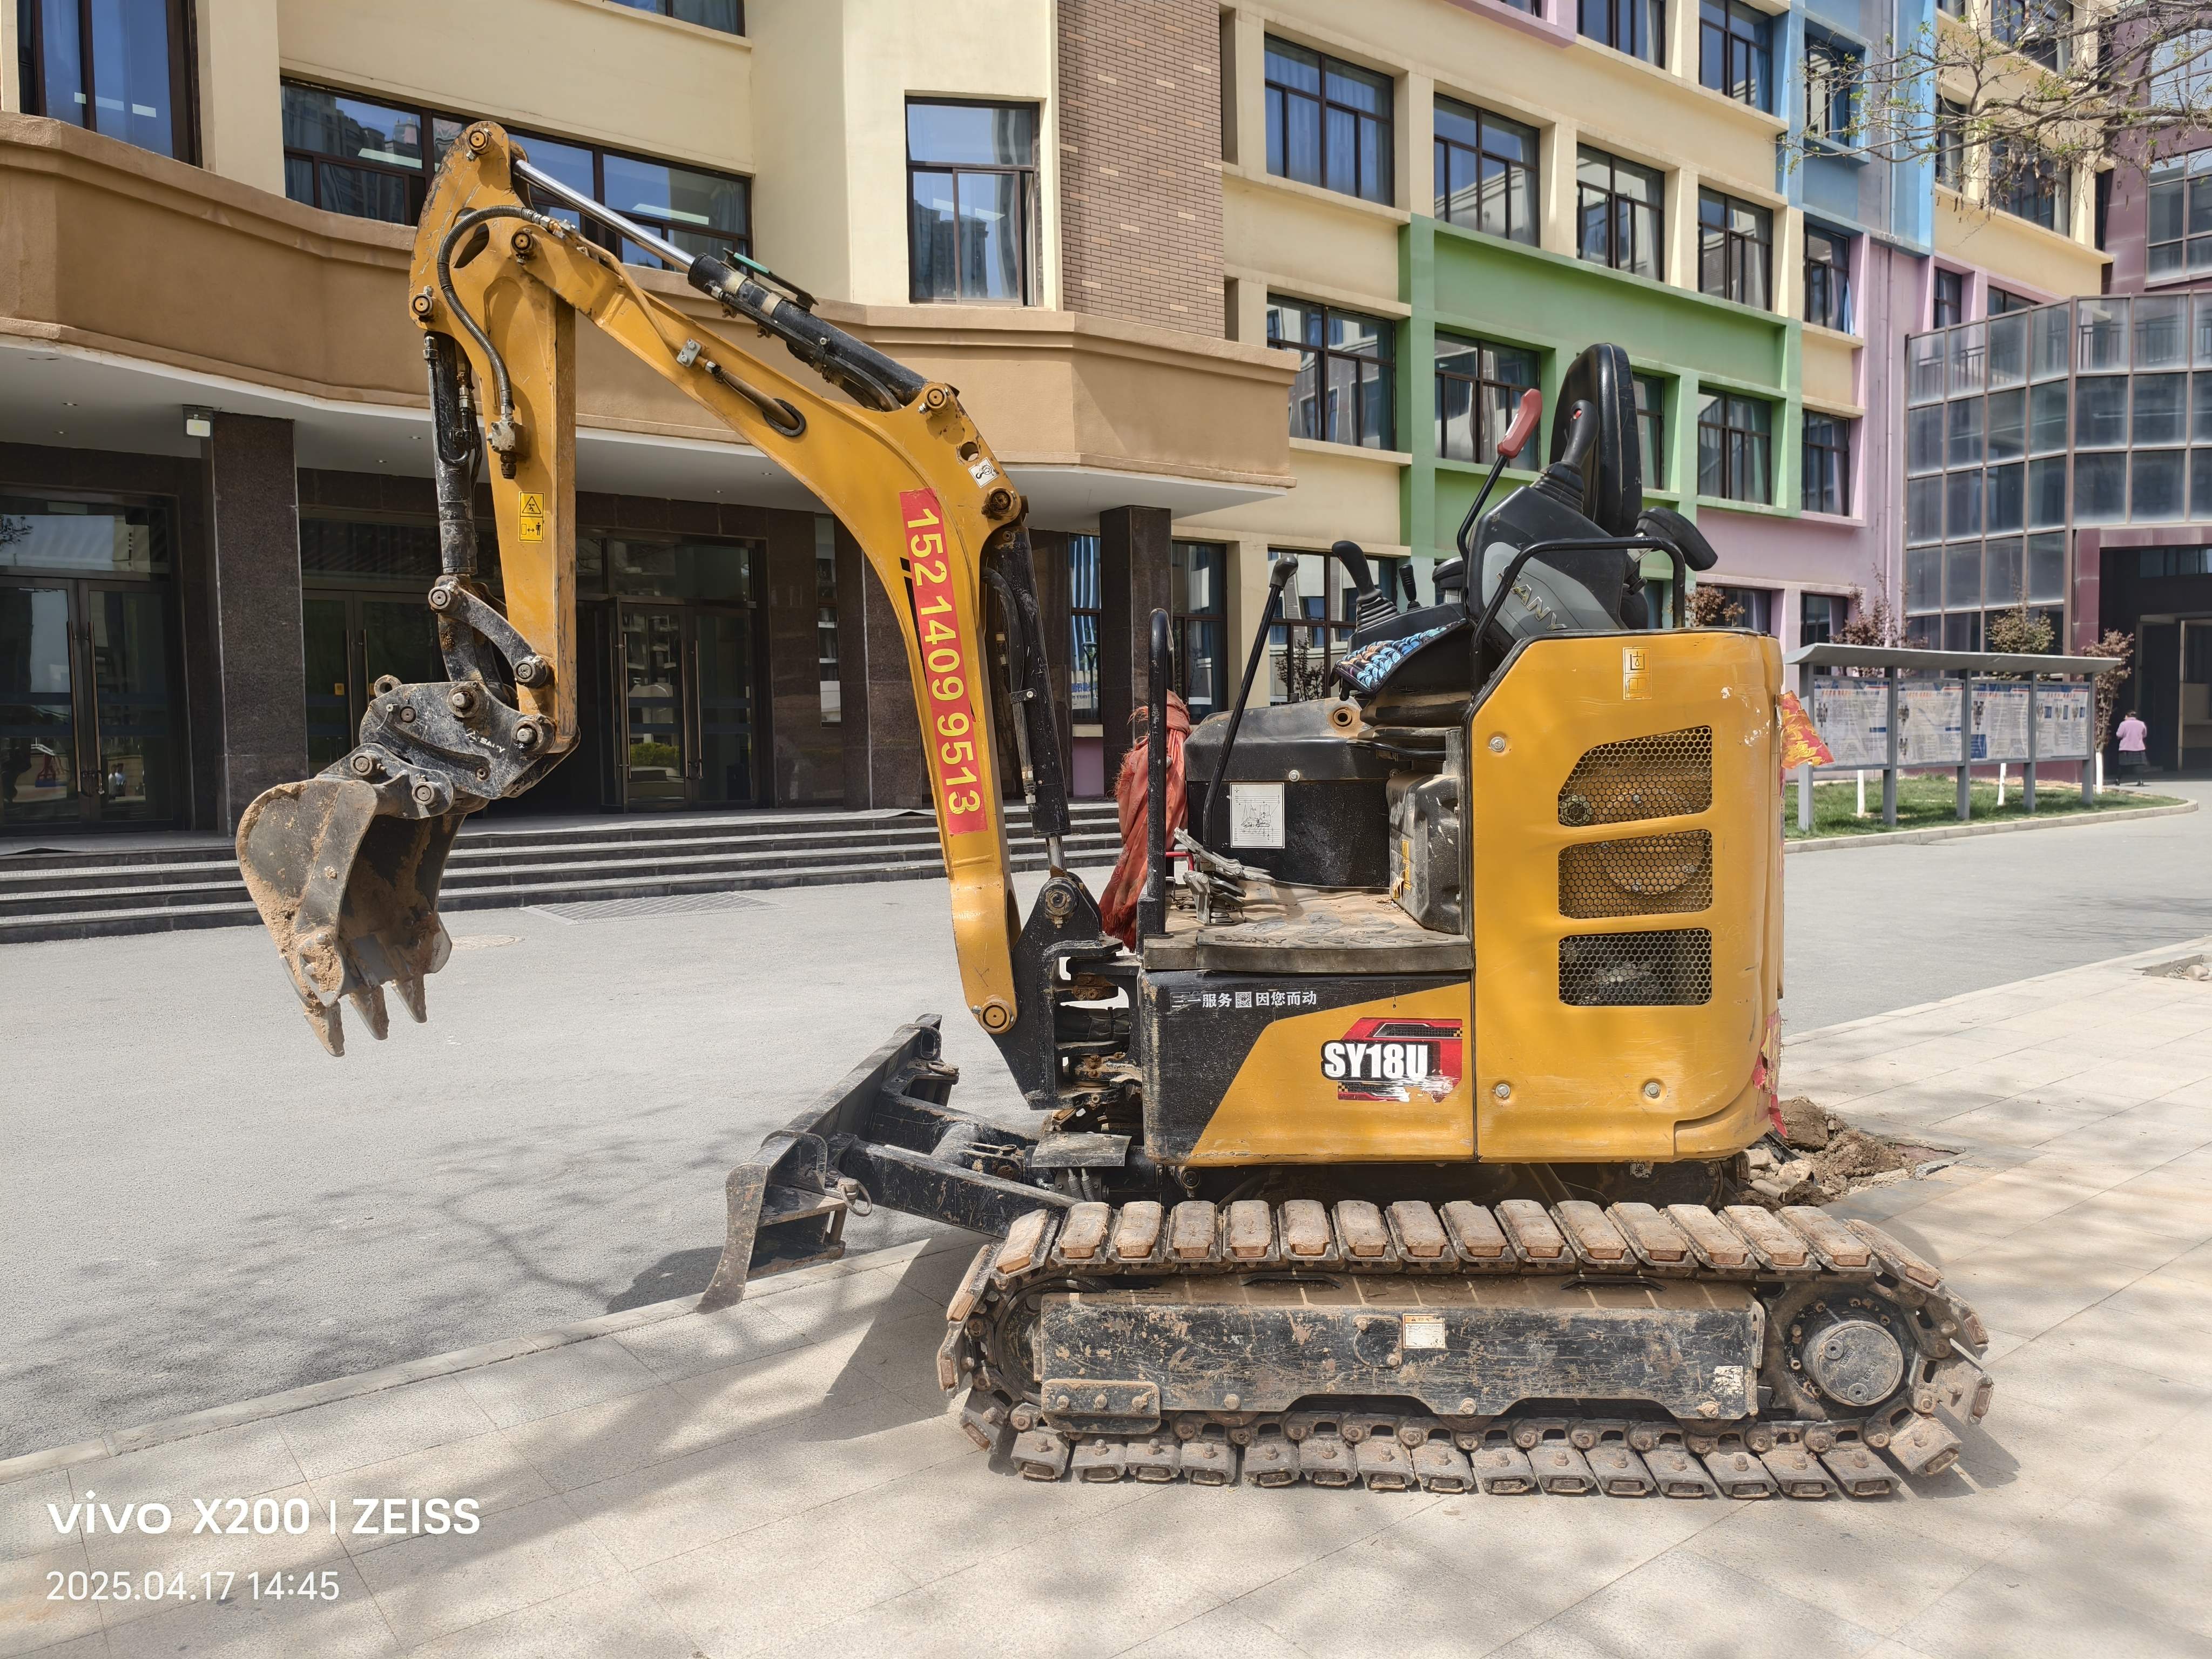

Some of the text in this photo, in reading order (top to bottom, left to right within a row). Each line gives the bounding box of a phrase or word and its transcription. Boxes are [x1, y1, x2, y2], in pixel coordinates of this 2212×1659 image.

[907, 508, 981, 814] 152 1409 9513
[1256, 990, 1317, 1006] 因您而动
[1324, 1042, 1428, 1080] SY18U
